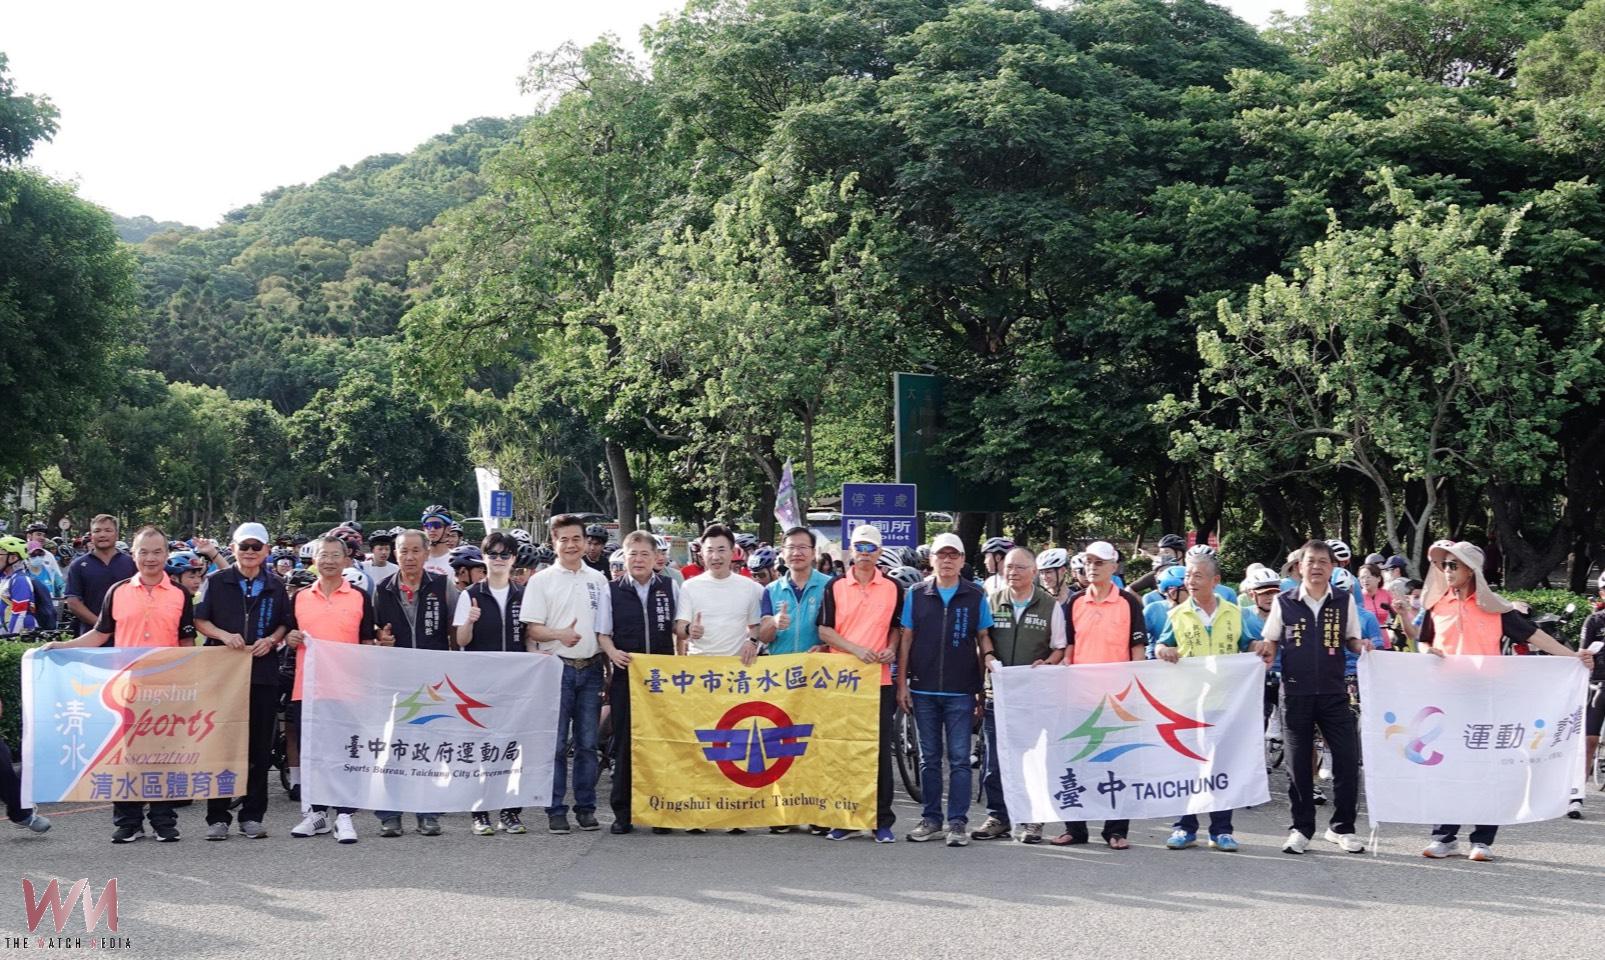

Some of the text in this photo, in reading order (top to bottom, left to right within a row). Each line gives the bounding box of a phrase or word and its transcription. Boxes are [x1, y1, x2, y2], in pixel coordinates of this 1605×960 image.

[122, 682, 199, 704] Qingshui
[644, 666, 862, 694] 臺中市清水區公所
[54, 700, 92, 770] 清水
[345, 735, 519, 763] 臺中市政府運動局
[105, 748, 199, 765] Association
[90, 769, 237, 799] 清水區體育會
[344, 763, 370, 773] Sports
[453, 769, 471, 779] City
[1054, 768, 1127, 810] 臺中
[1132, 772, 1229, 801] TAICHUNG
[649, 795, 711, 812] Qingshui
[716, 795, 765, 810] district
[834, 797, 859, 813] city
